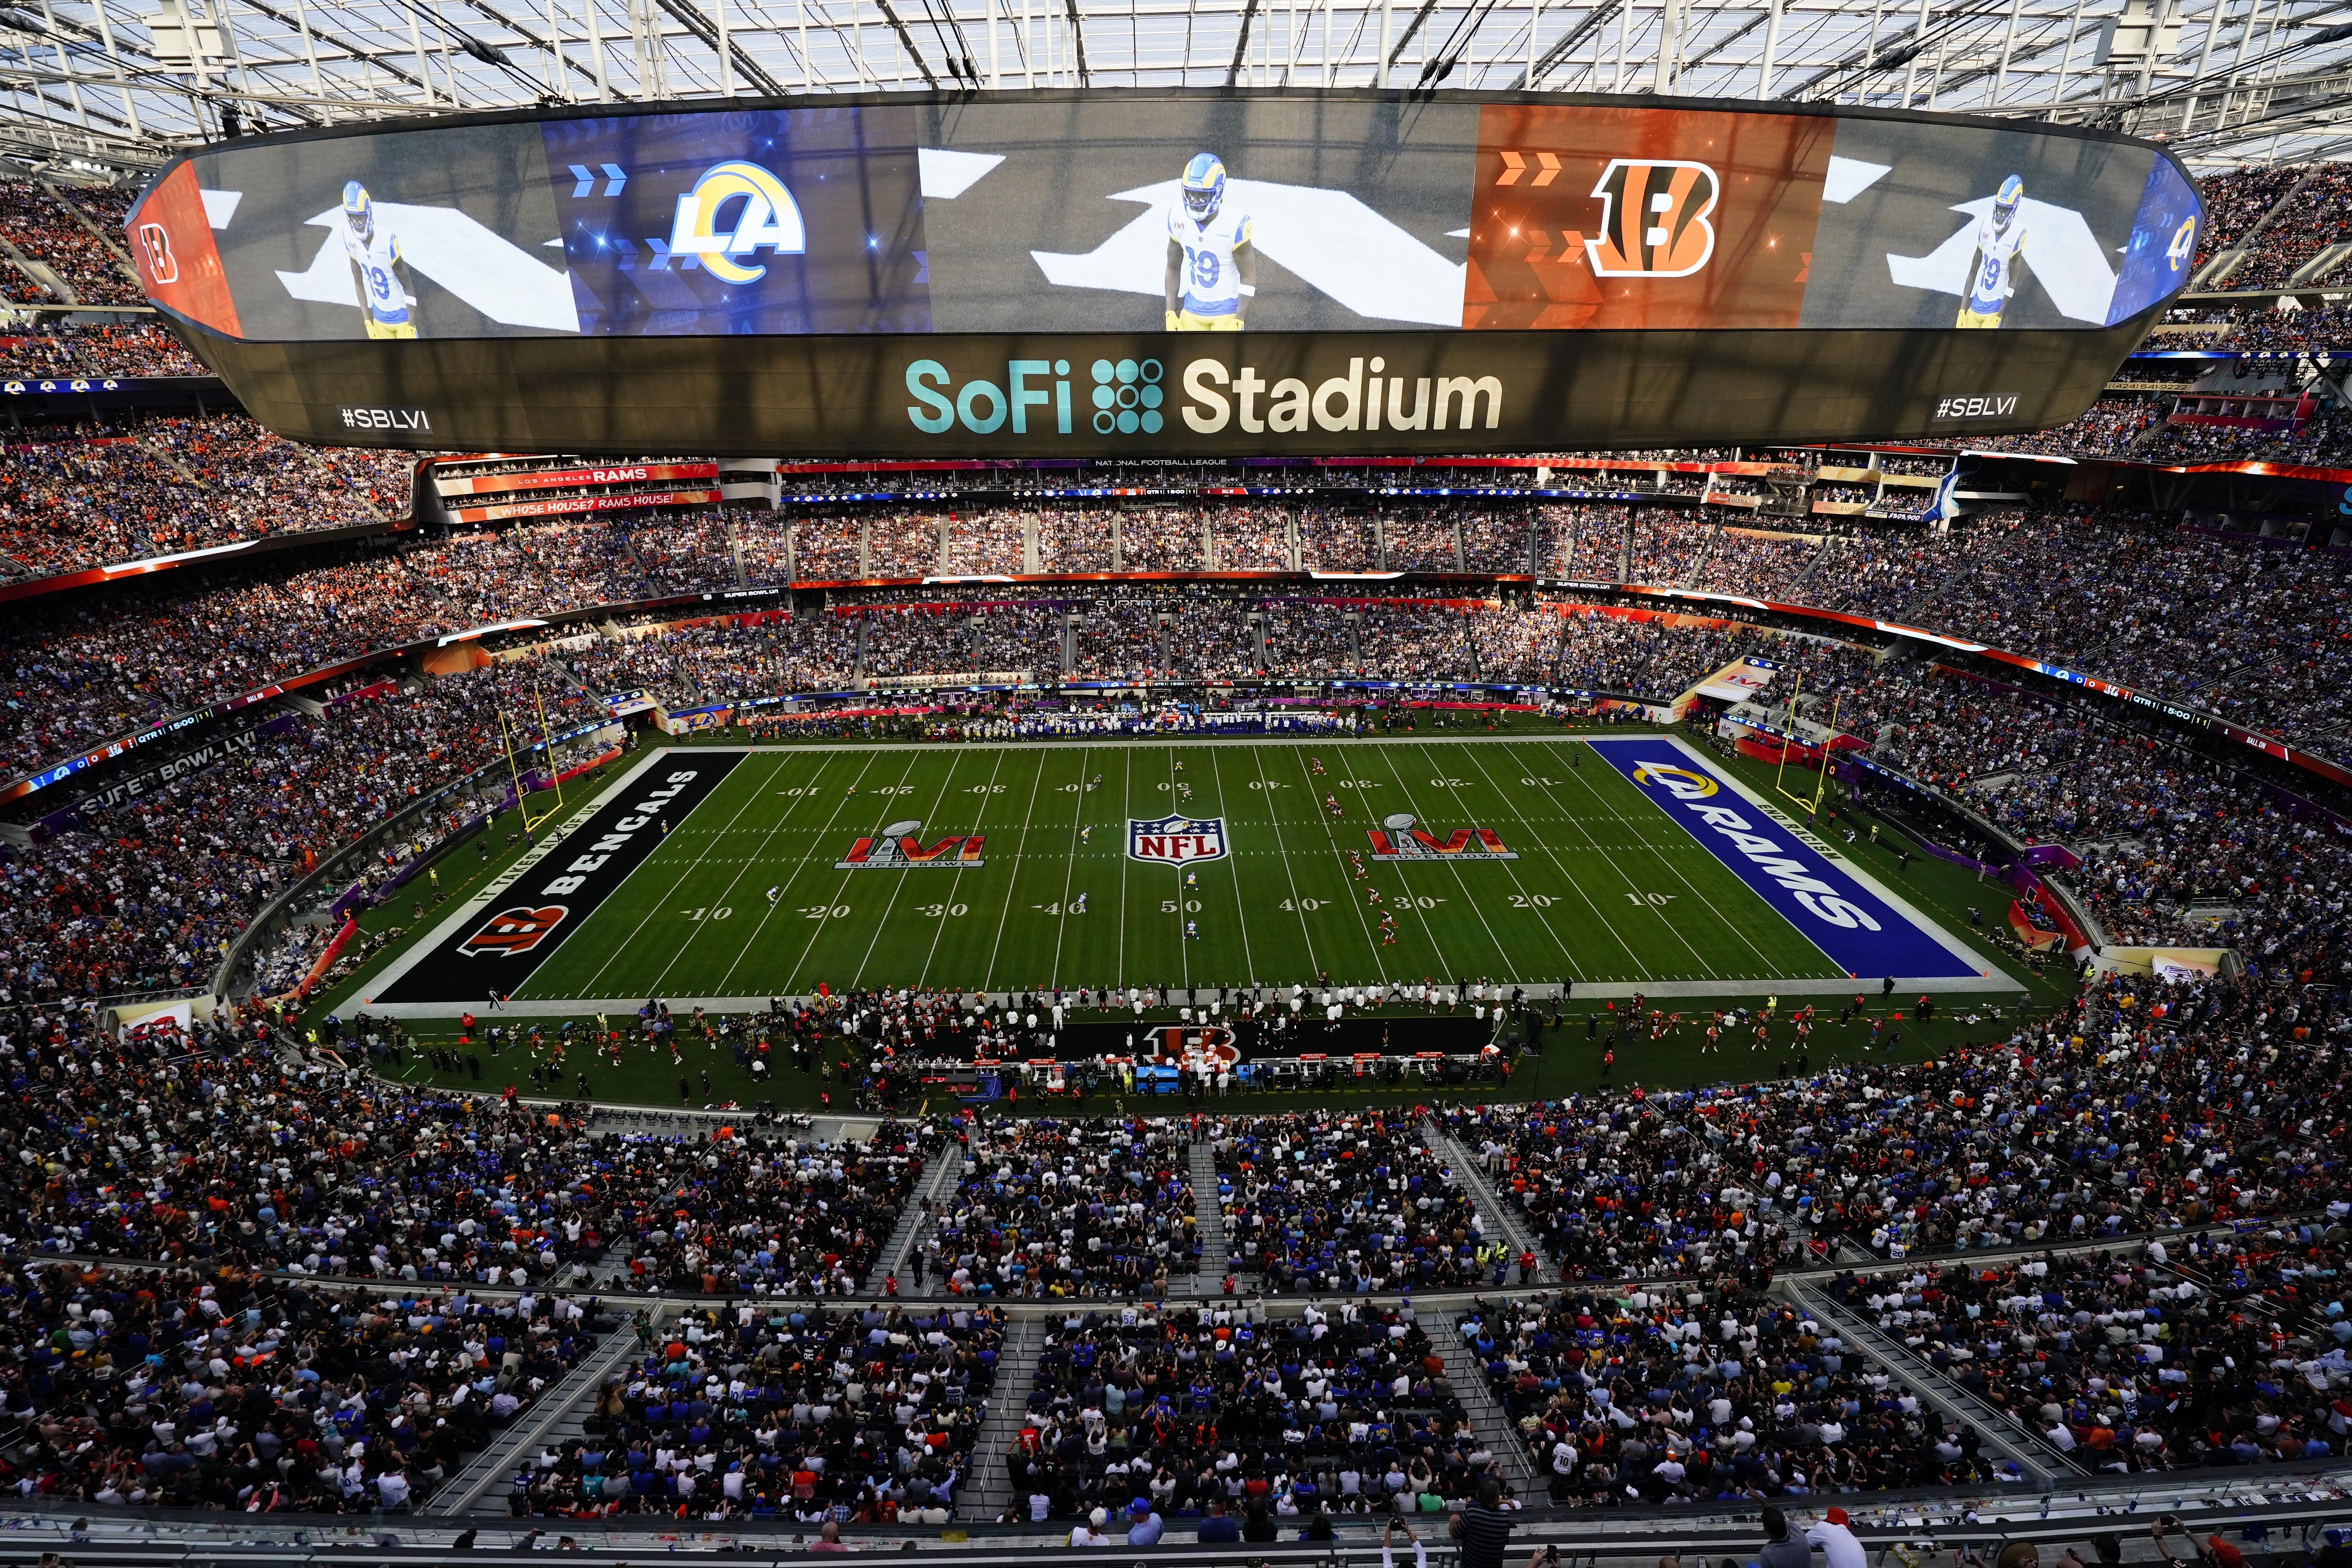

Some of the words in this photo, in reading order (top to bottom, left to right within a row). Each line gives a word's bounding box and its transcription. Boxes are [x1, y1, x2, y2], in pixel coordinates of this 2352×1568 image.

[1185, 245, 1220, 288] 19
[1980, 253, 2000, 290] 19
[361, 263, 390, 299] 19
[906, 359, 1072, 434] SoFi
[1182, 356, 1503, 434] Stadium
[1936, 396, 2017, 418] #SBLVI
[342, 408, 430, 430] #SBLVI
[593, 468, 648, 482] RAMS
[501, 503, 546, 517] WHOSE
[547, 500, 594, 512] HOUSE?
[598, 499, 630, 508] RAMS
[633, 493, 673, 505] HOUSE!
[1888, 511, 1920, 521] $303,900
[247, 695, 257, 703] BALL
[256, 692, 264, 701] ON
[2163, 704, 2190, 720] 15:00
[169, 717, 194, 730] 15:00
[1791, 742, 1807, 751] RAMS
[2246, 735, 2258, 746] BALL
[2258, 739, 2266, 749] ON
[1157, 782, 1190, 791] 50
[1248, 781, 1281, 790] 40
[1339, 780, 1372, 789] 30
[1430, 779, 1465, 787] 20
[1521, 777, 1556, 786] 10
[786, 787, 822, 796] 10
[880, 786, 915, 795] 20
[973, 785, 1007, 793] 30
[540, 770, 698, 896] BENGALS
[1756, 804, 1788, 821] END
[1783, 823, 1843, 860] RACISM
[473, 887, 497, 902] IT
[499, 853, 542, 887] TAKES
[563, 818, 583, 830] OF
[579, 804, 602, 815] US
[1138, 835, 1217, 859] NFL
[1685, 803, 1881, 931] RAMS
[1278, 898, 1319, 911] 40
[1394, 896, 1436, 909] 30
[1508, 895, 1552, 908] 20
[1623, 892, 1668, 906] 10
[805, 905, 851, 919] 20
[925, 903, 968, 917] 30
[1044, 901, 1084, 915] 40
[1160, 900, 1202, 913] 50
[687, 907, 732, 920] 10
[2047, 893, 2068, 919] CINCINNATI
[2067, 916, 2083, 940] BENGALS
[1124, 1316, 1134, 1325] 52
[1711, 1348, 1717, 1357] 9
[1559, 1455, 1569, 1465] 10
